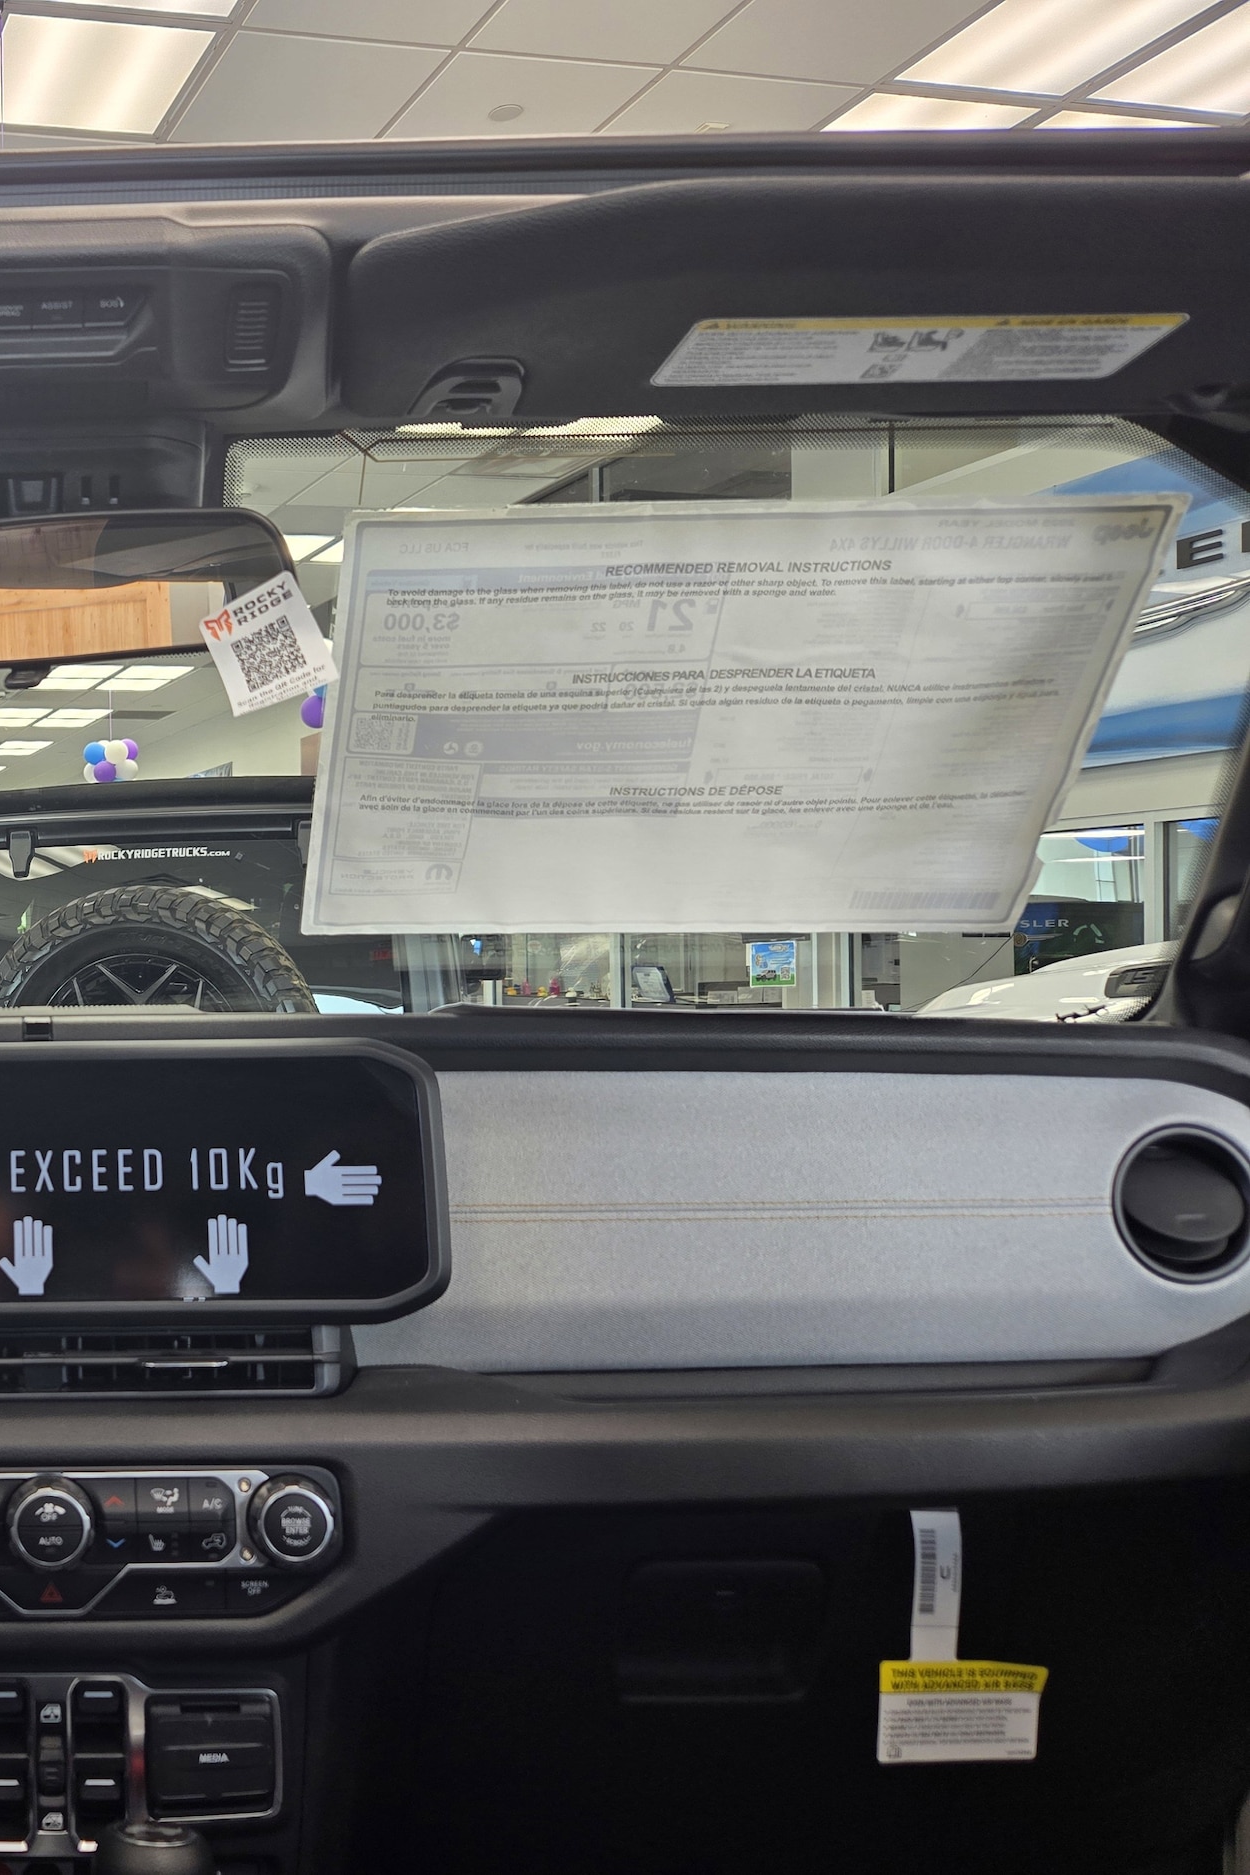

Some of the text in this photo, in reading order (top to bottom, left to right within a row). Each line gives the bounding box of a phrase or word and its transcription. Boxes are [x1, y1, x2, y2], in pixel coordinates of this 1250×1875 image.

[41, 301, 72, 309] ASSIST
[605, 559, 892, 577] RECOMMENDED REMOVAL INSTRUCTIONS
[388, 588, 399, 597] To
[401, 588, 425, 597] avoid
[428, 588, 463, 600] damage
[466, 587, 476, 596] to
[477, 586, 492, 596] the
[494, 587, 518, 599] glass
[520, 585, 544, 595] when
[546, 583, 588, 596] removing
[591, 583, 608, 593] this
[635, 580, 647, 590] do
[649, 580, 663, 589] not
[666, 581, 683, 589] use
[720, 580, 729, 588] or
[731, 578, 754, 588] other
[757, 577, 783, 589] sharp
[821, 577, 831, 587] To
[833, 577, 867, 586] remove
[870, 576, 887, 586] this
[232, 580, 288, 618] ROCKY
[411, 587, 807, 607] from the If any residue remains on the may removed with sponge and
[236, 589, 295, 627] RIDGE
[572, 667, 877, 684] INSTRUCCIONES PARA DESPRENDER LA ETIQUETA
[375, 683, 921, 701] Para desprender etiqueta una esquina superior las lentamente del NUNCA
[373, 697, 841, 713] puntiagudos para desprender etiqueta que dañar queda residuo etiqueta
[609, 783, 784, 798] INSTRUCTIONS DE DÉPOSE
[1019, 919, 1070, 929] SLER
[11, 1149, 163, 1192] EXCEED
[189, 1147, 284, 1200] 10Kg
[202, 1498, 222, 1511] A/C
[40, 1513, 58, 1522] OFF
[281, 1517, 311, 1527] BROWSE
[285, 1527, 310, 1535] ENTER
[39, 1536, 63, 1545] AUTO
[241, 1580, 270, 1588] SCREEN
[248, 1588, 262, 1596] OFF
[891, 1668, 916, 1679] THIS
[919, 1668, 963, 1680] VEHICLE
[965, 1669, 977, 1679] IS
[891, 1680, 920, 1691] WITH
[922, 1680, 981, 1691] ADVANCED
[983, 1680, 1001, 1691] AIR
[198, 1752, 230, 1764] MEDIA
